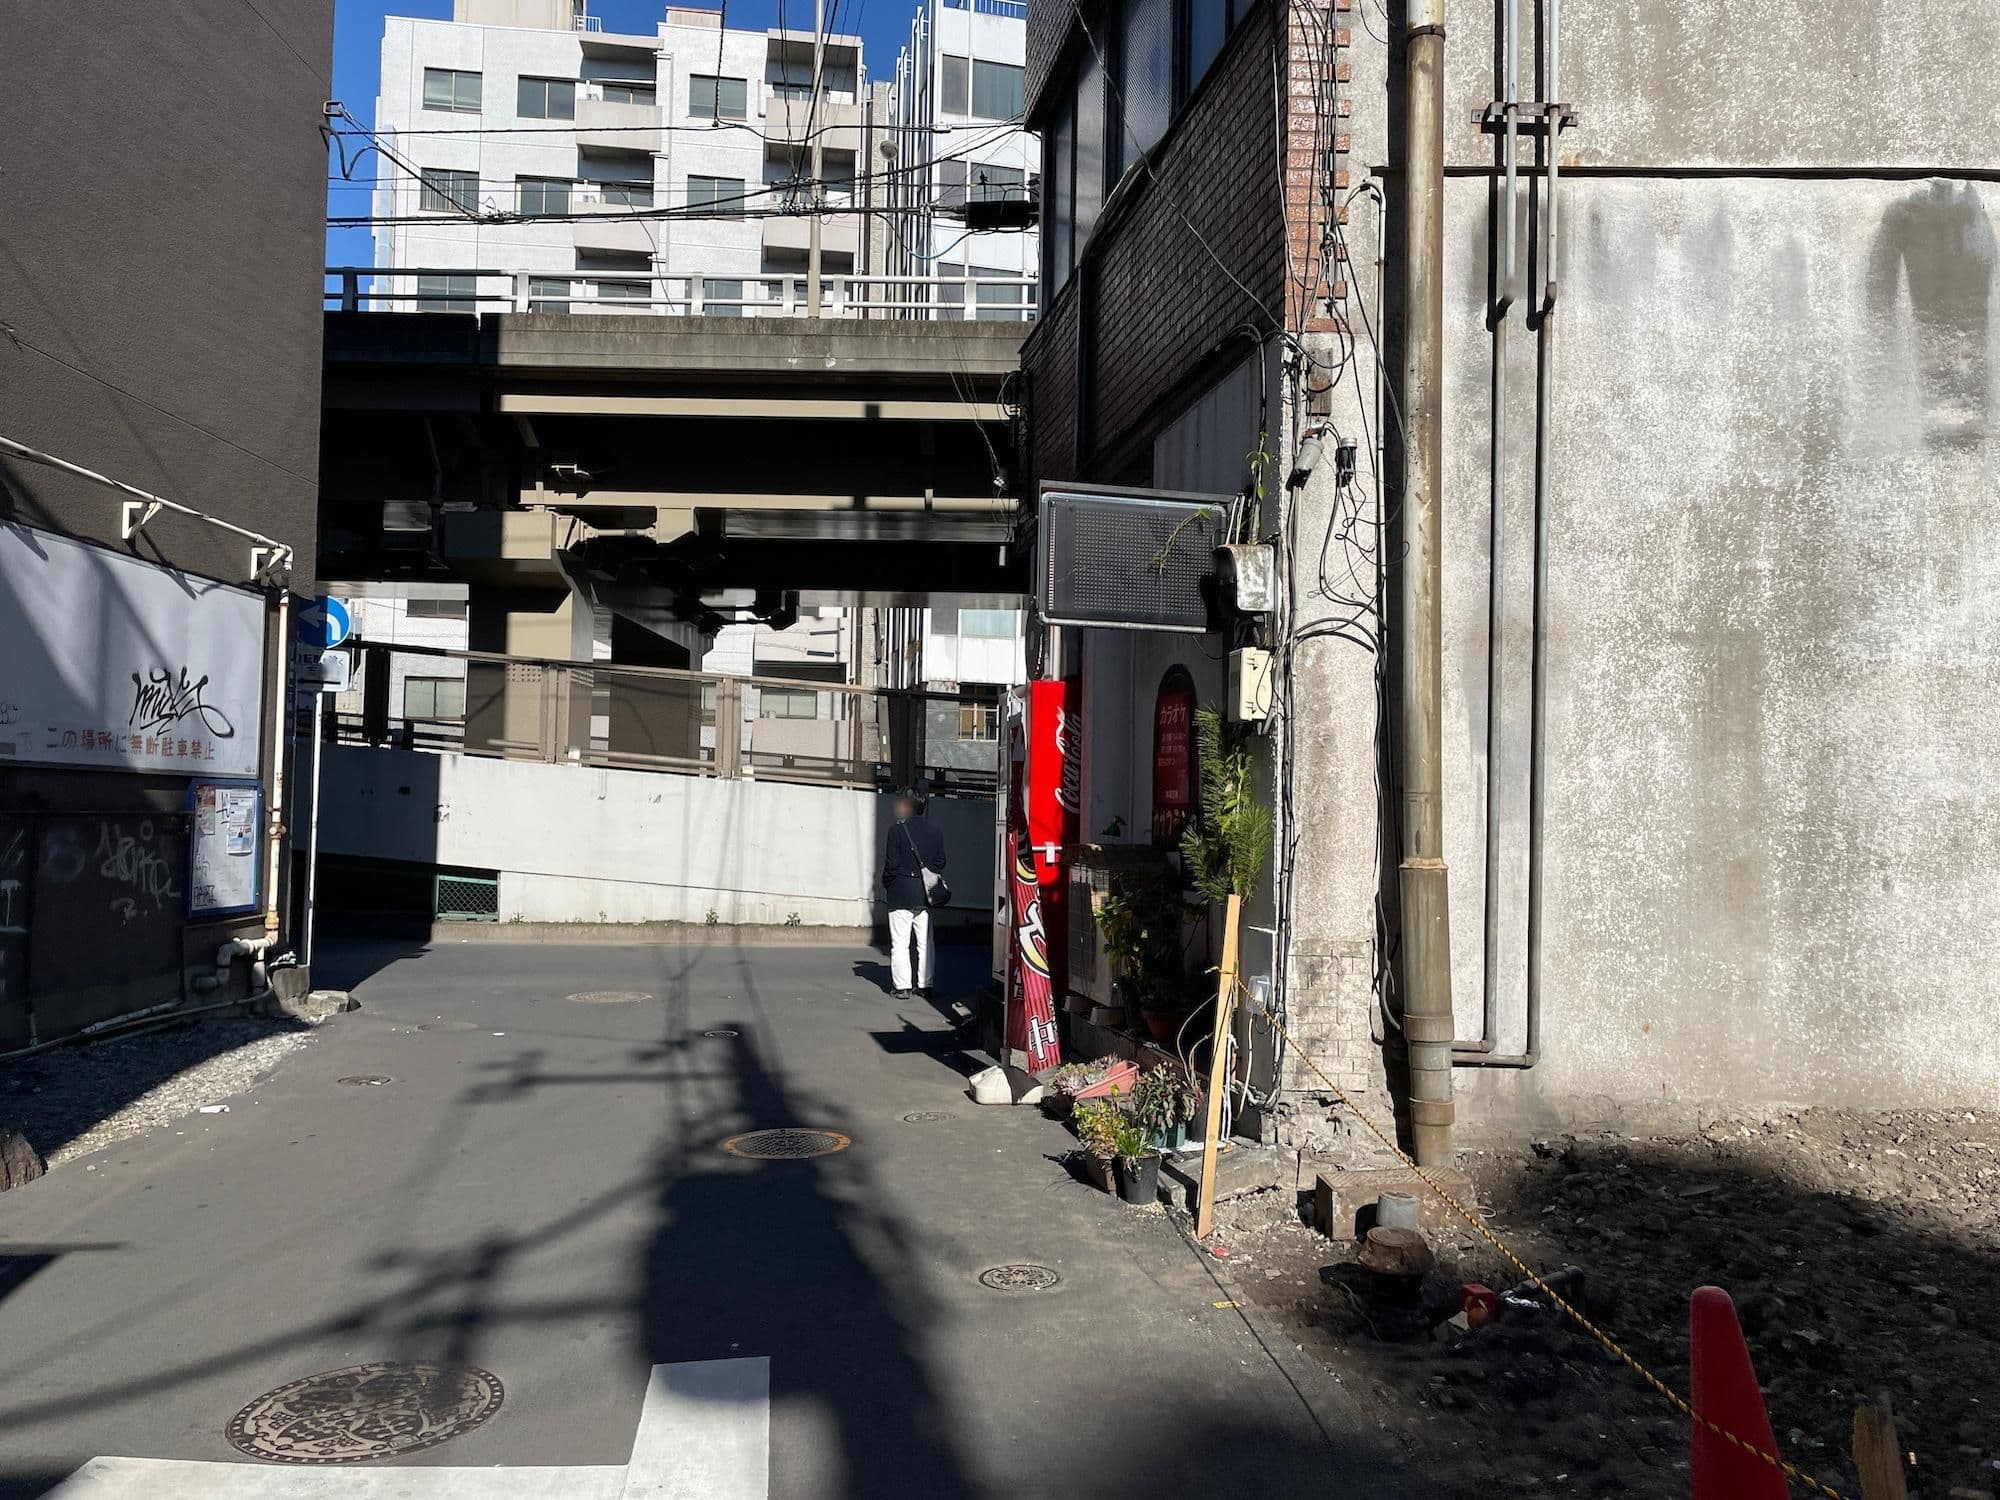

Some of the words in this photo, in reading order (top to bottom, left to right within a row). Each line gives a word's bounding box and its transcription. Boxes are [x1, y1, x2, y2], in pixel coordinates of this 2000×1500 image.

[1159, 703, 1187, 725] カラオケ
[46, 727, 215, 761] この場所に無断駐車禁止
